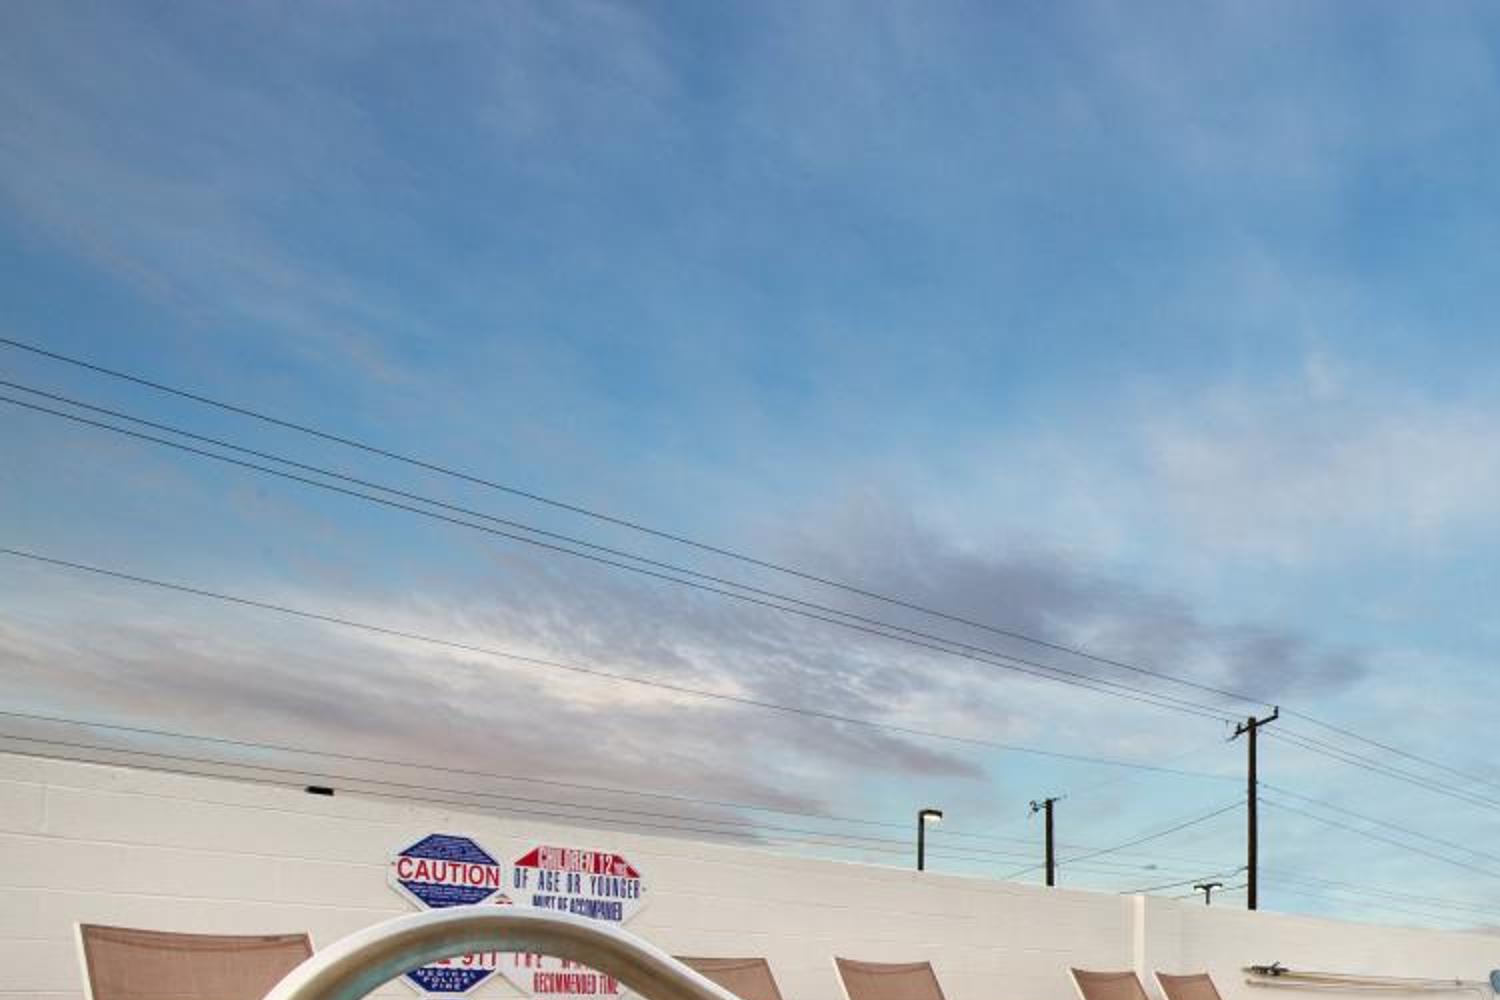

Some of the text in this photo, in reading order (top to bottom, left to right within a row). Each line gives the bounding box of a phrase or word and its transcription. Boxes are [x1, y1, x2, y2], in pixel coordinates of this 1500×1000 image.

[397, 857, 500, 887] CAUTION
[514, 867, 640, 899] OF AGE OR YOUNGER
[534, 972, 597, 995] RECOMMENDED
